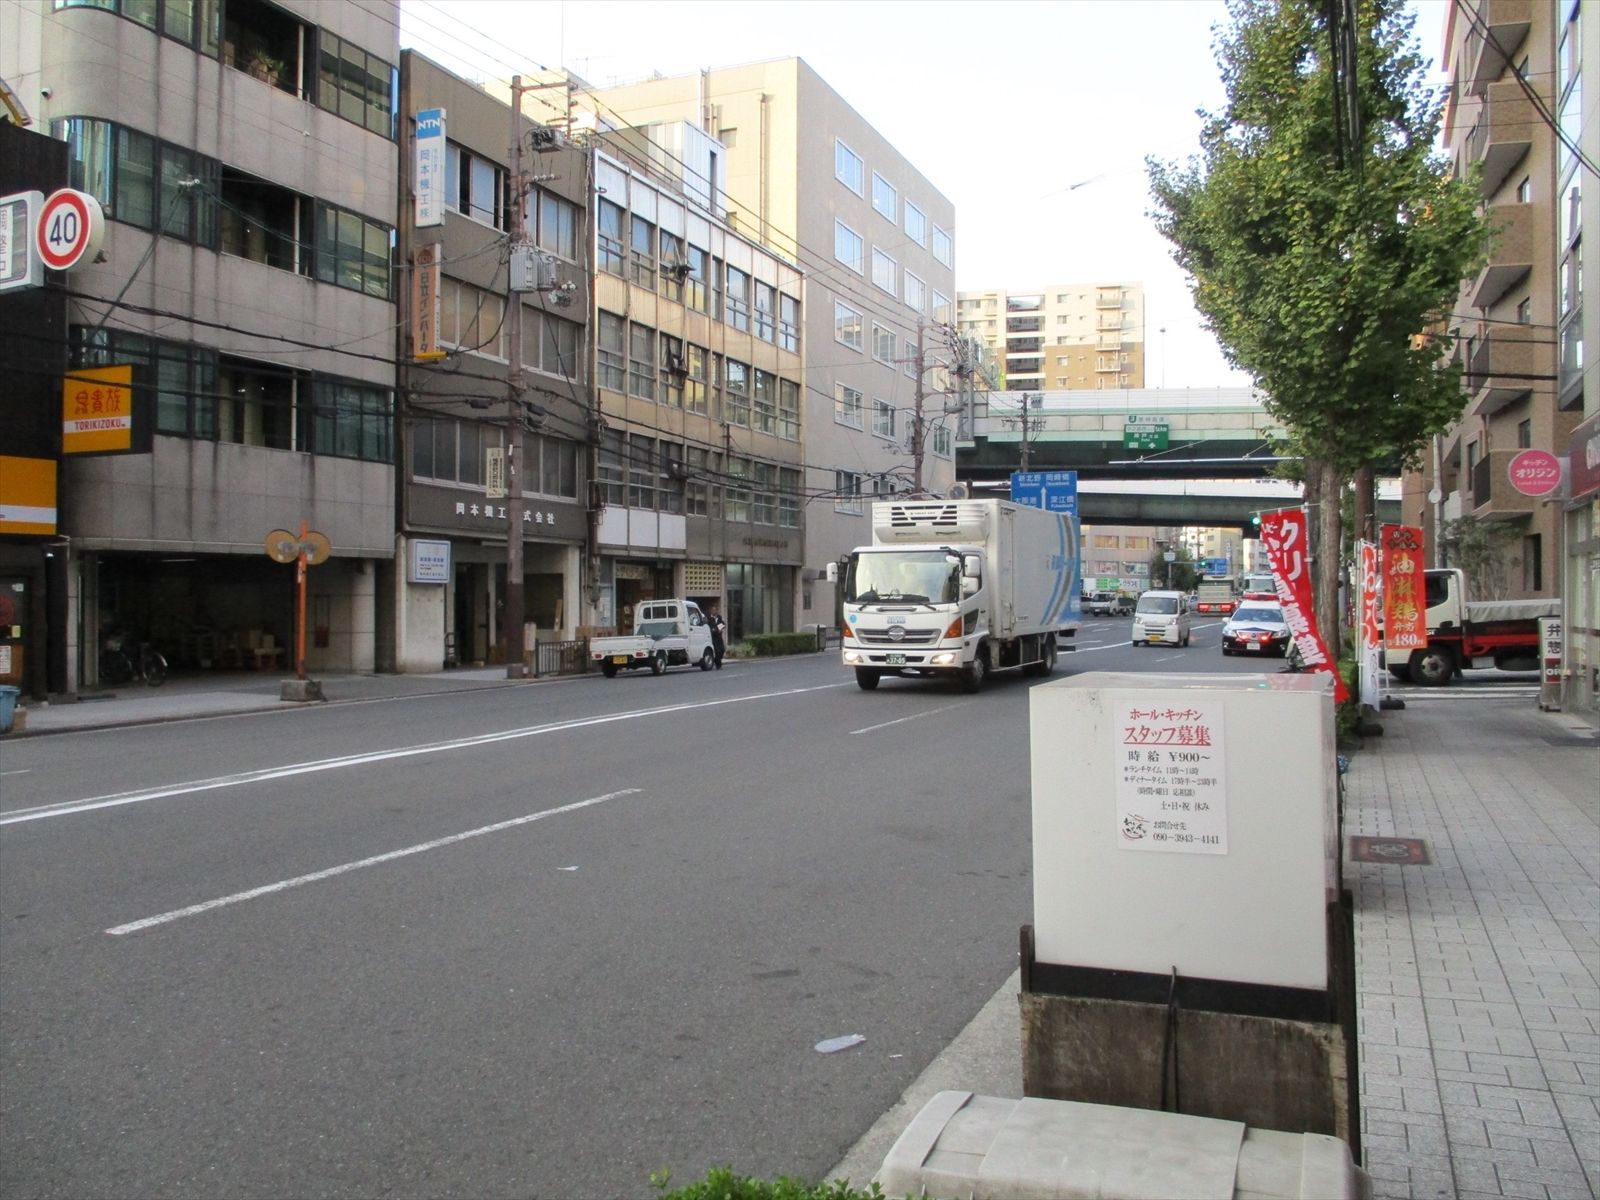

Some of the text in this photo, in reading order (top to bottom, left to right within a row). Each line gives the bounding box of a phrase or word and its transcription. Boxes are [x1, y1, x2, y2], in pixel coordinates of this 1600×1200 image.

[418, 118, 441, 130] NTN
[50, 212, 77, 246] 40
[74, 388, 121, 415] 鳥貴族
[75, 419, 121, 431] TORIKIZOKU
[1516, 468, 1556, 478] オリジン
[1124, 725, 1211, 745] スタッフ募集
